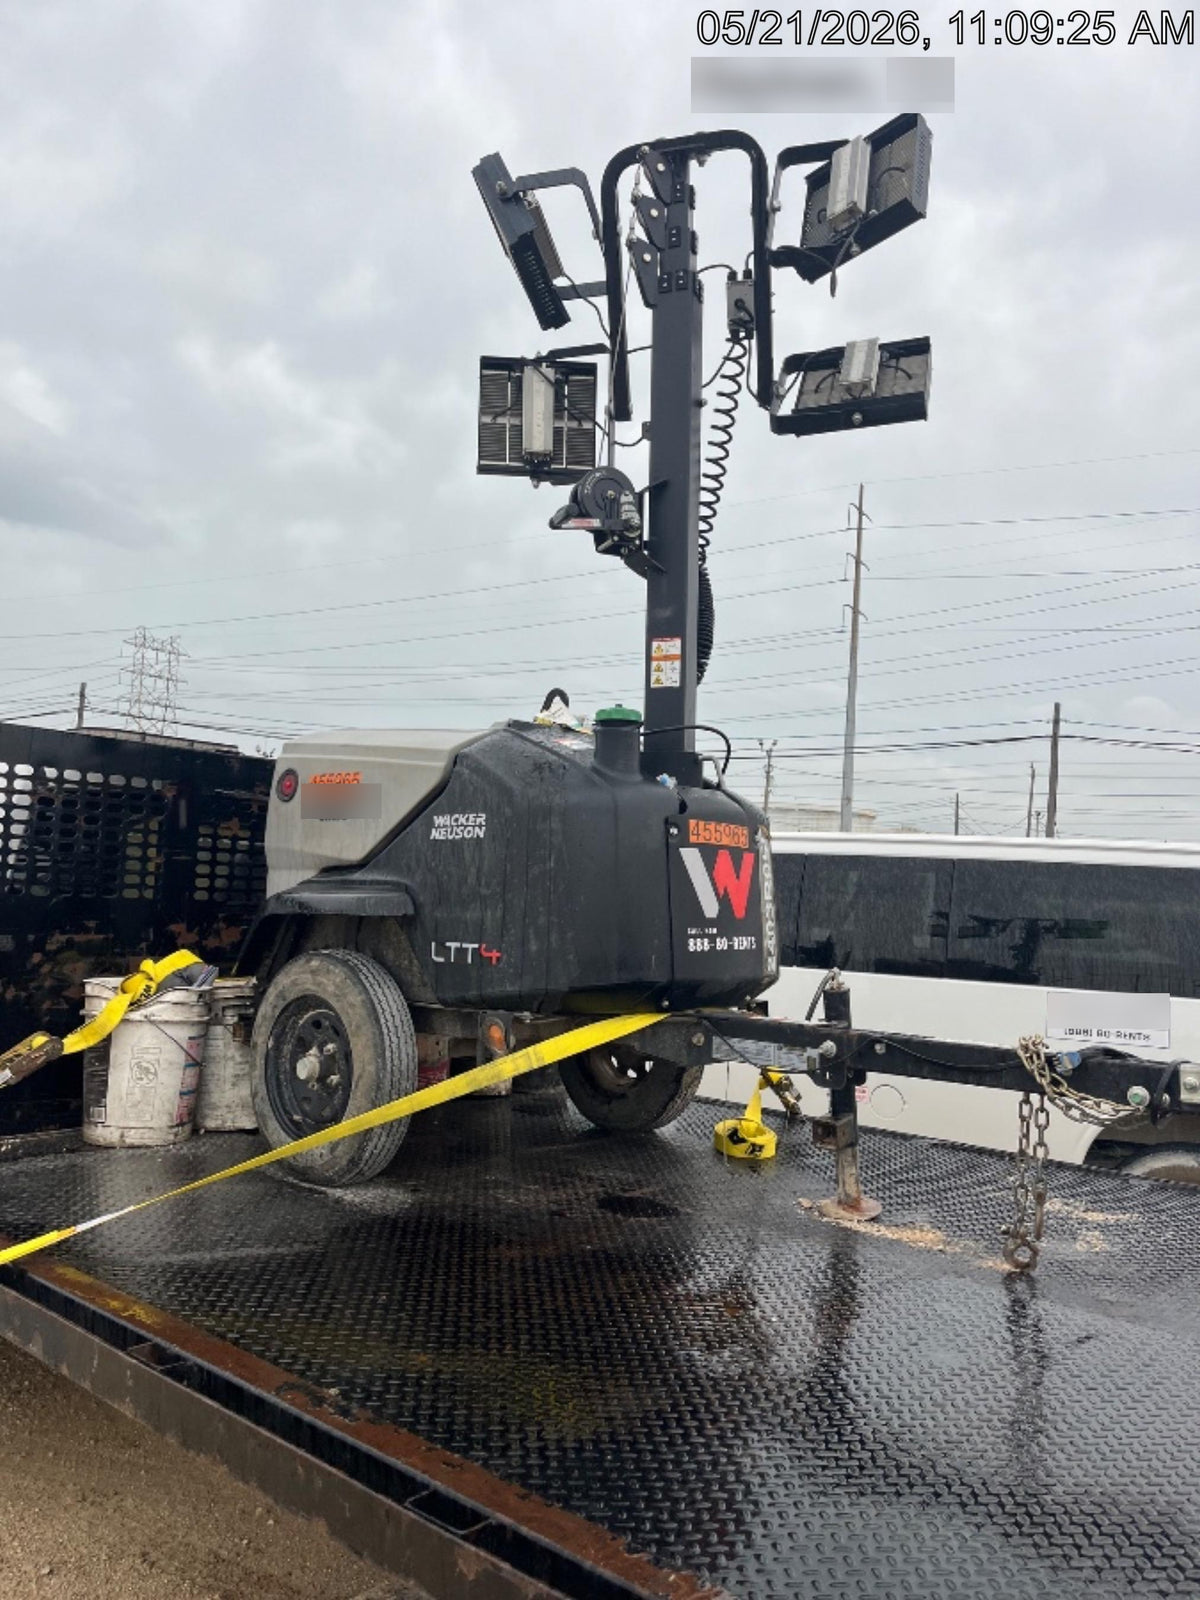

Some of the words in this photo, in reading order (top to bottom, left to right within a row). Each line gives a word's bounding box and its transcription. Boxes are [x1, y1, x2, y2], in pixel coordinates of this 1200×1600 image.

[433, 813, 486, 827] WACKER
[430, 826, 486, 840] NEUSON
[431, 941, 501, 965] LTT4
